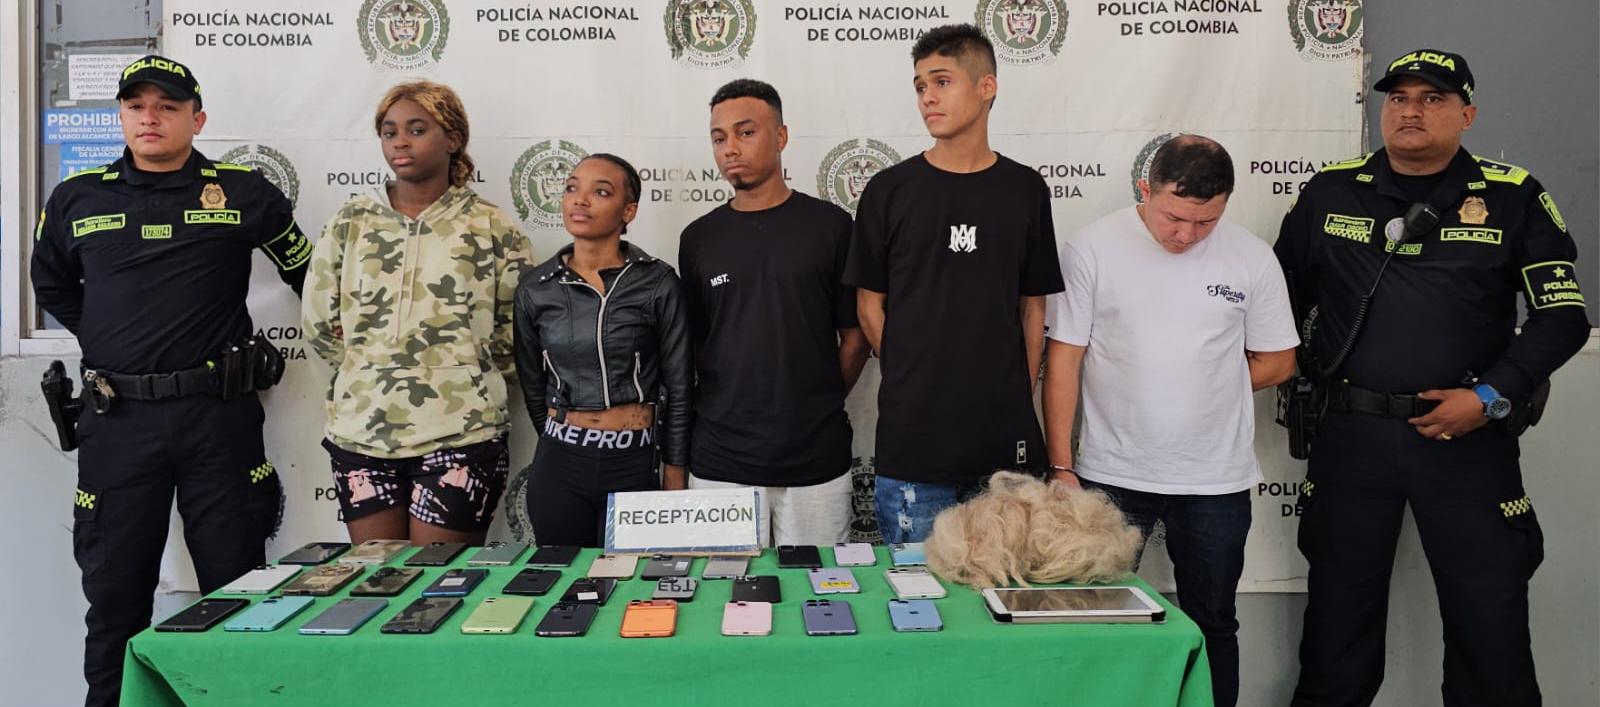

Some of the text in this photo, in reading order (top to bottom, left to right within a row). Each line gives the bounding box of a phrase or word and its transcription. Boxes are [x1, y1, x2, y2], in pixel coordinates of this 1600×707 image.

[477, 4, 639, 22] POLICÍA NACIONAL
[785, 3, 949, 21] POLICÍA NACIONAL
[1174, 0, 1262, 13] NACIONAL
[172, 9, 334, 26] POLICÍA NACIONAL
[498, 26, 616, 42] DE COLOMBIA
[807, 28, 829, 41] DE
[1121, 19, 1239, 36] DE COLOMBIA
[195, 33, 313, 46] DE COLOMBIA
[47, 113, 118, 126] PROHIBI
[1039, 163, 1106, 178] CIONAL
[1250, 157, 1316, 174] POLICÍA
[651, 189, 672, 202] DE
[1273, 182, 1293, 195] DE
[710, 273, 730, 287] MST.
[582, 429, 634, 449] PRO
[619, 504, 753, 525] RECEPTACIÓN
